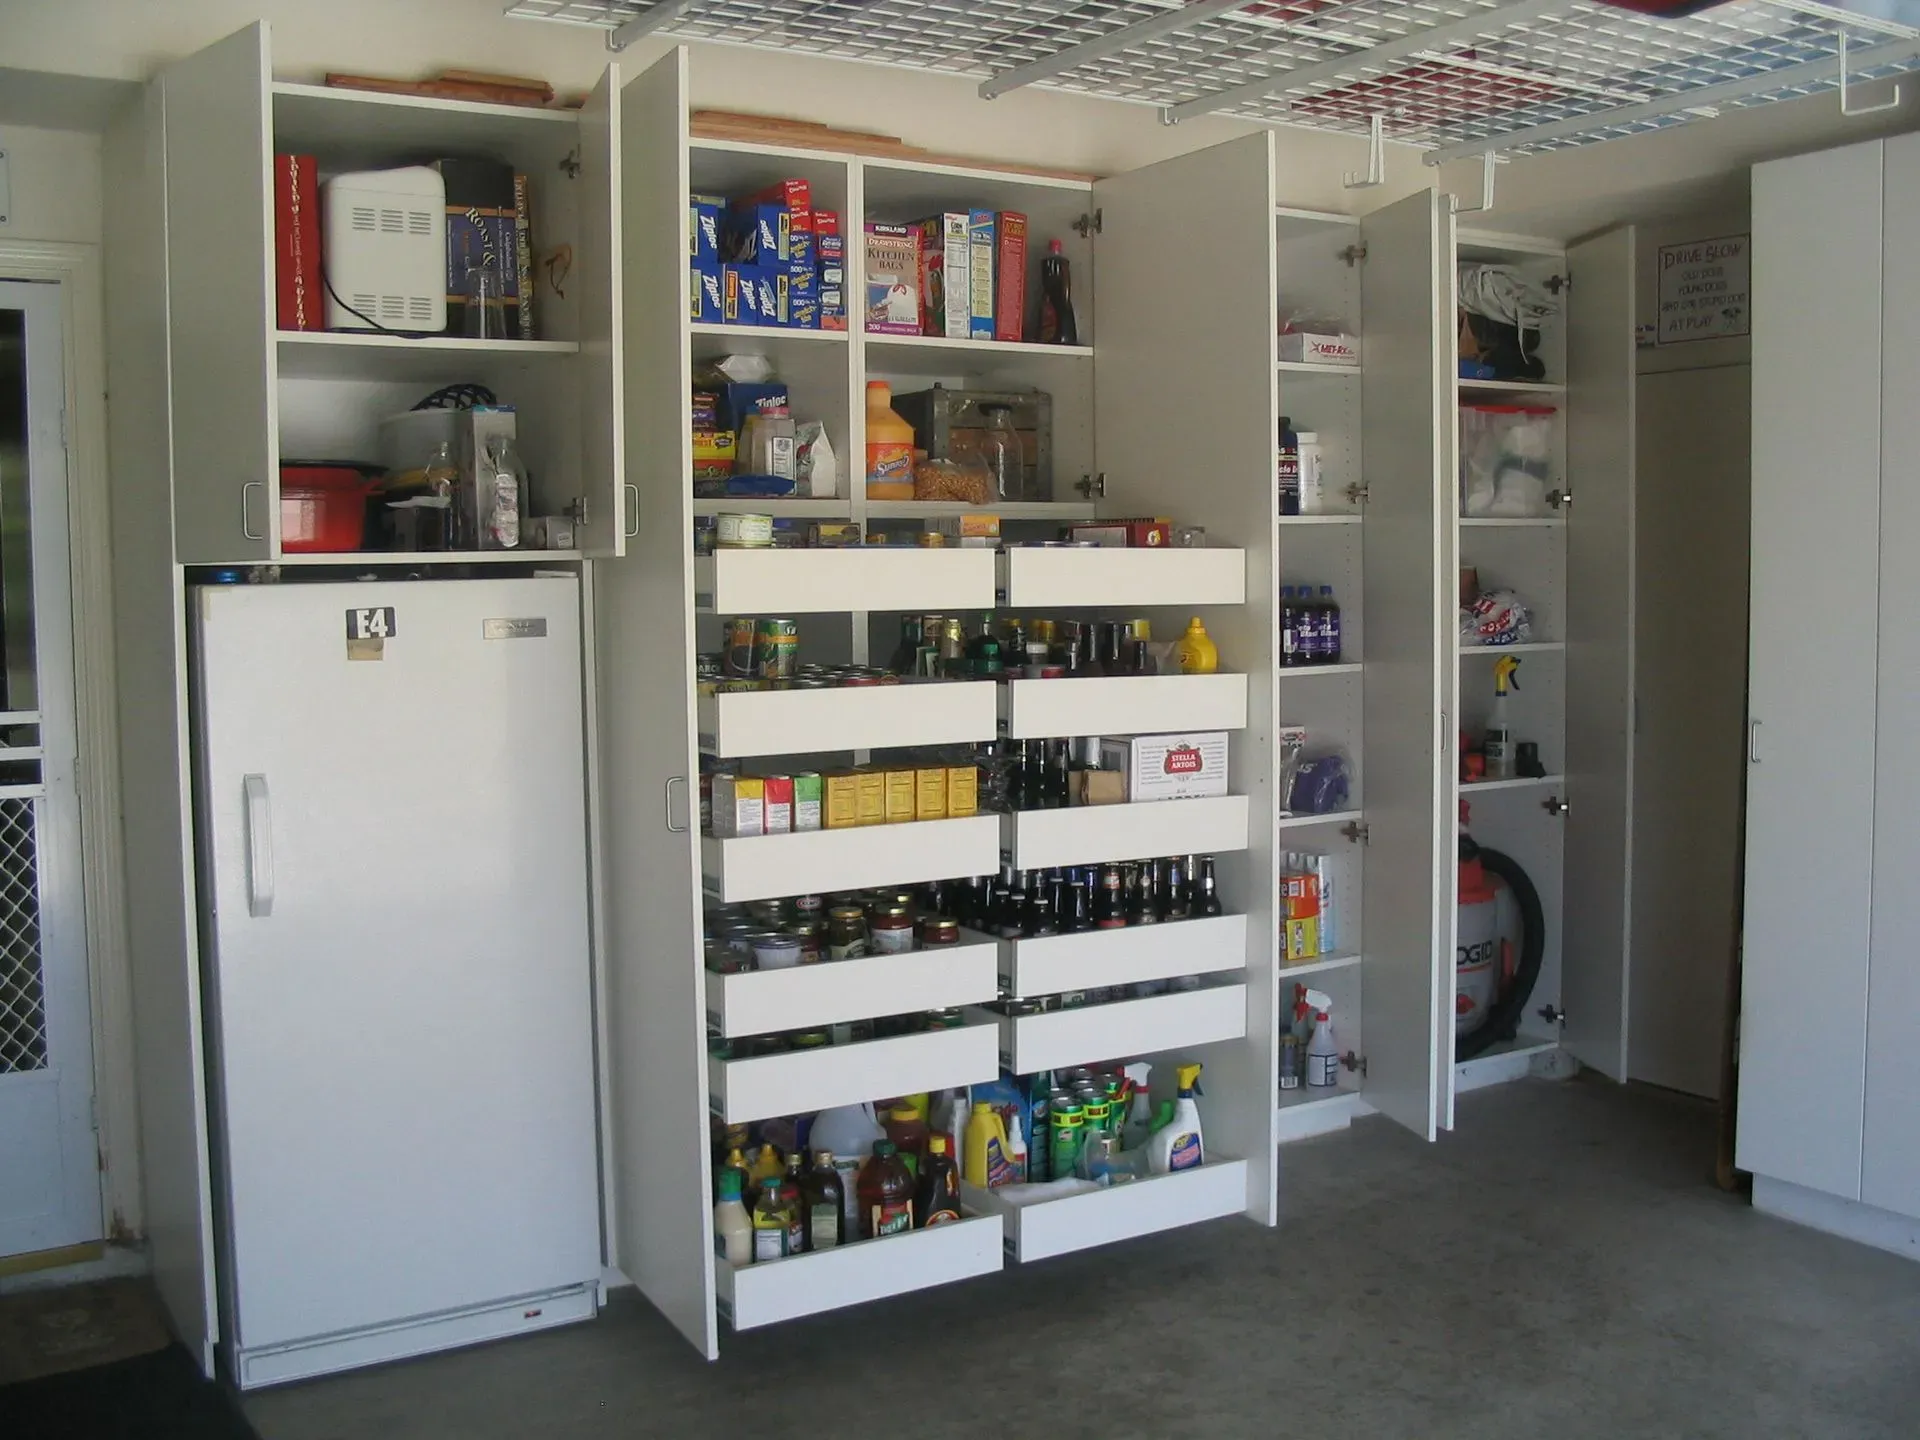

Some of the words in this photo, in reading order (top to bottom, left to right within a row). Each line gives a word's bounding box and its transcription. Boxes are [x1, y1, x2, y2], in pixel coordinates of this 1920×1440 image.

[465, 207, 494, 249] ROAST
[482, 252, 497, 265] &
[700, 215, 718, 249] Ziploc
[760, 219, 777, 250] Ziploc
[875, 225, 907, 234] KIRKLAND
[867, 248, 915, 261] KITCHEN
[868, 238, 914, 249] DRAWSTRING
[1664, 248, 1702, 269] DRIVE
[1705, 244, 1742, 263] SLOW
[879, 261, 904, 270] BAGS
[702, 275, 721, 309] Ziploc
[740, 279, 756, 310] Ziploc
[758, 287, 776, 316] Ziploc
[356, 608, 388, 638] E4
[1171, 754, 1196, 762] STELLA
[1171, 761, 1197, 769] ARTOIS
